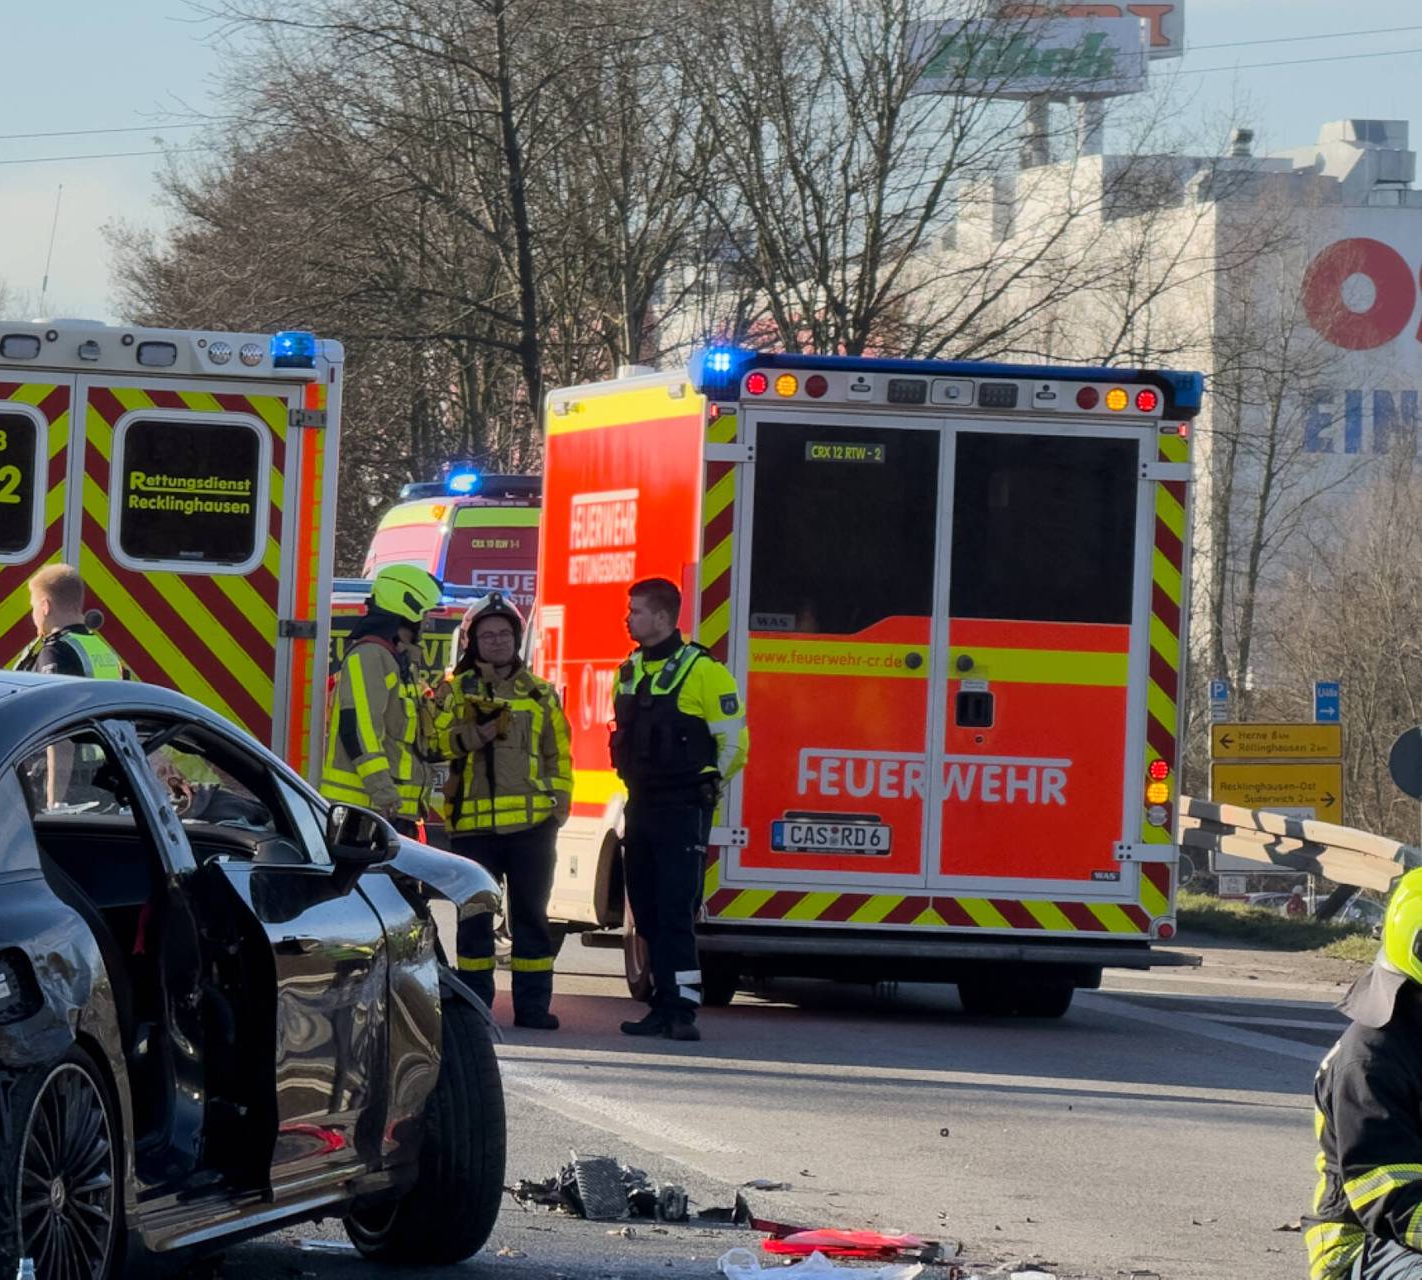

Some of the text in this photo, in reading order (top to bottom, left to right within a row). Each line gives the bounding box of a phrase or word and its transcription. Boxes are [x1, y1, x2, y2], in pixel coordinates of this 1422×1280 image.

[1302, 237, 1422, 350] O
[811, 446, 830, 458] CRX
[833, 447, 843, 459] 12
[845, 447, 865, 459] RTW
[130, 471, 251, 495] Rettungsdienst
[129, 494, 250, 514] Recklinghausen
[756, 617, 787, 627] WAS
[753, 651, 902, 668] www.feuerwehr-cr.de
[1214, 683, 1224, 697] P
[797, 748, 1073, 805] FEUERWEHR
[790, 825, 881, 847] CAS RD 6
[1094, 871, 1116, 880] WAS
